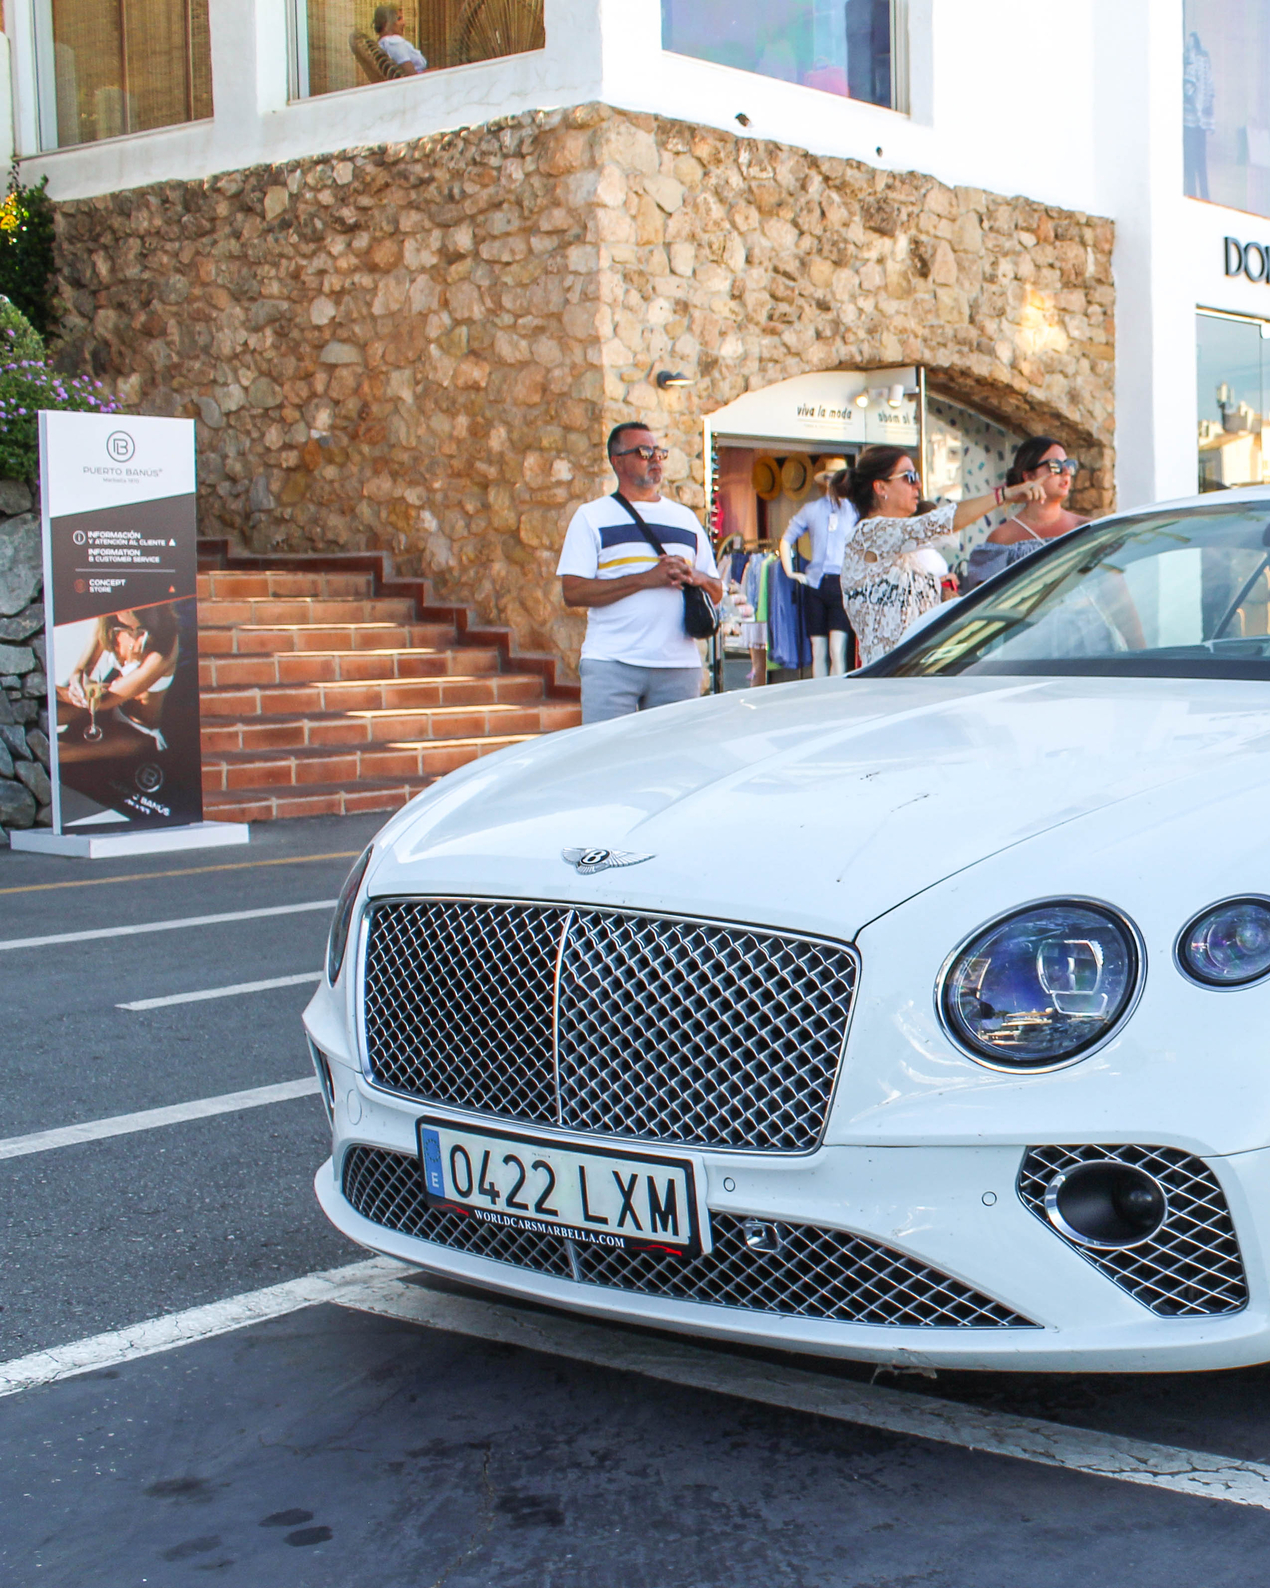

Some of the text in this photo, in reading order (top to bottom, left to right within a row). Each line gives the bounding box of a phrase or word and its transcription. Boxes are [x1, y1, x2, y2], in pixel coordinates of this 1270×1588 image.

[797, 403, 852, 420] viva la moda
[83, 466, 122, 476] PUERTO
[88, 530, 141, 539] INFORMACIÓN
[139, 539, 166, 547] CLIENTE
[88, 548, 141, 556] INFORMATION
[431, 1172, 440, 1188] E
[449, 1144, 680, 1237] 0422 LXM
[474, 1209, 625, 1248] WORLDCARSMARBELLA.COM
